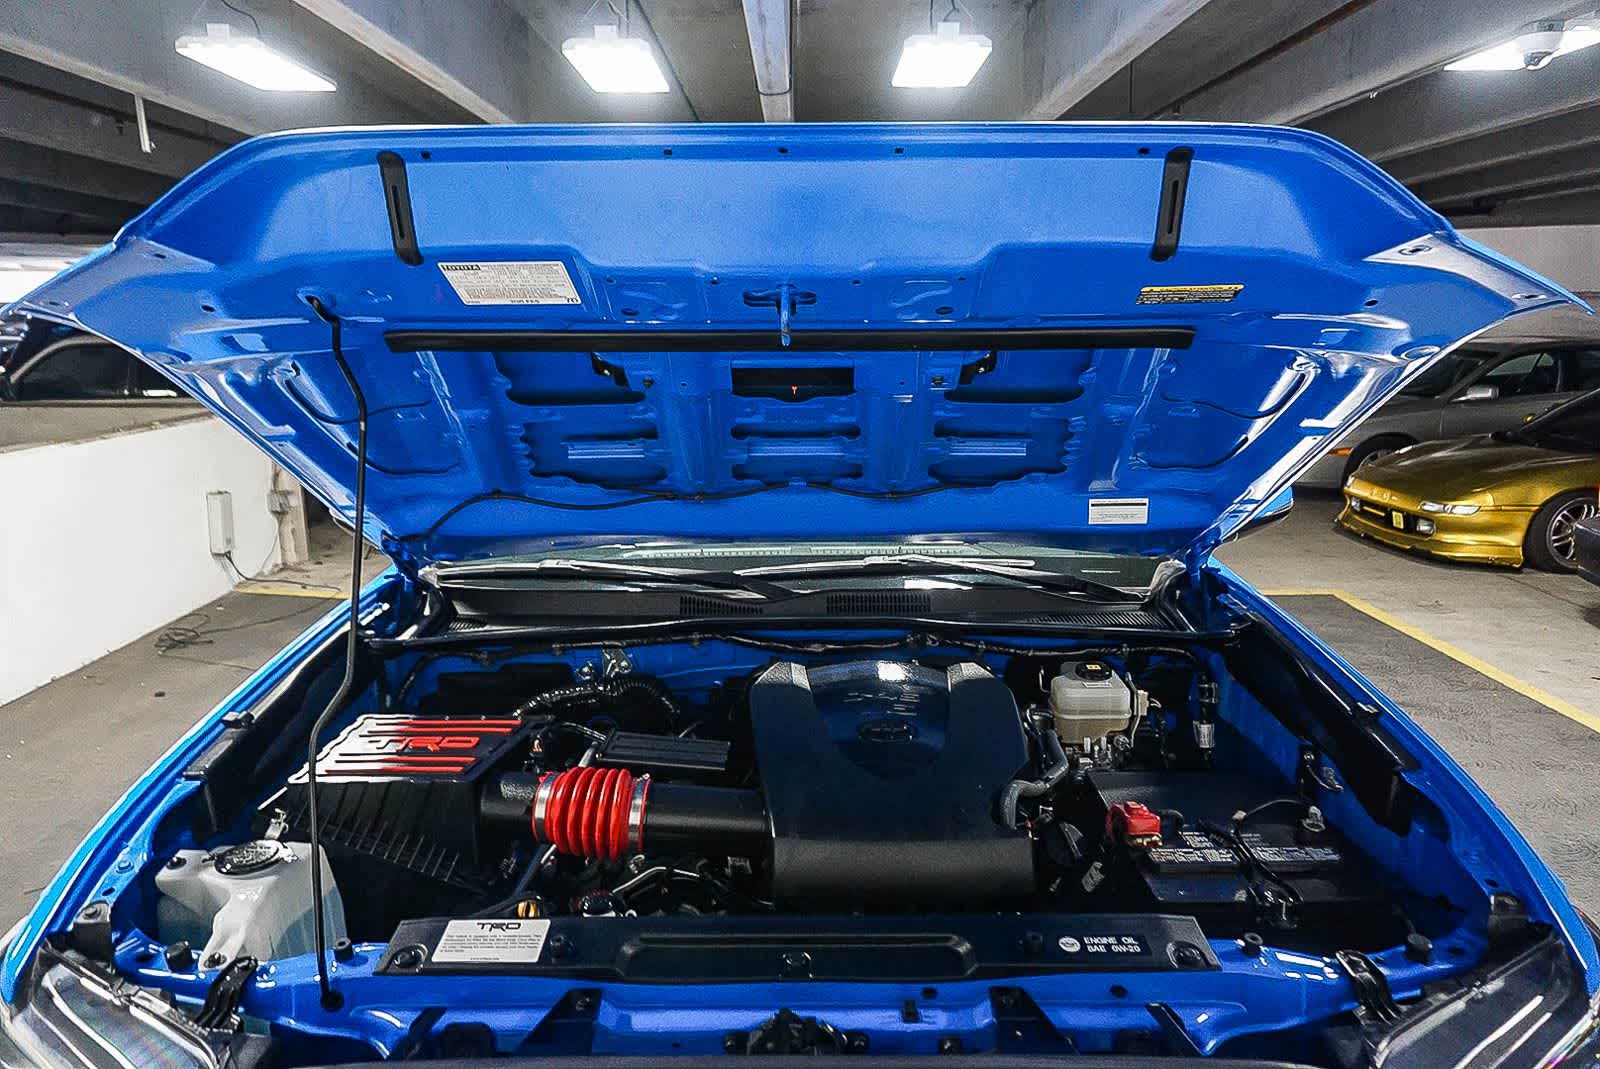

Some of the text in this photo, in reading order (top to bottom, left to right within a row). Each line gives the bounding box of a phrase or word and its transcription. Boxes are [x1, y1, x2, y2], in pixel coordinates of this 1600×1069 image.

[368, 736, 480, 752] TRD
[477, 922, 521, 932] TRD
[1083, 936, 1138, 944] ENGINE OIL
